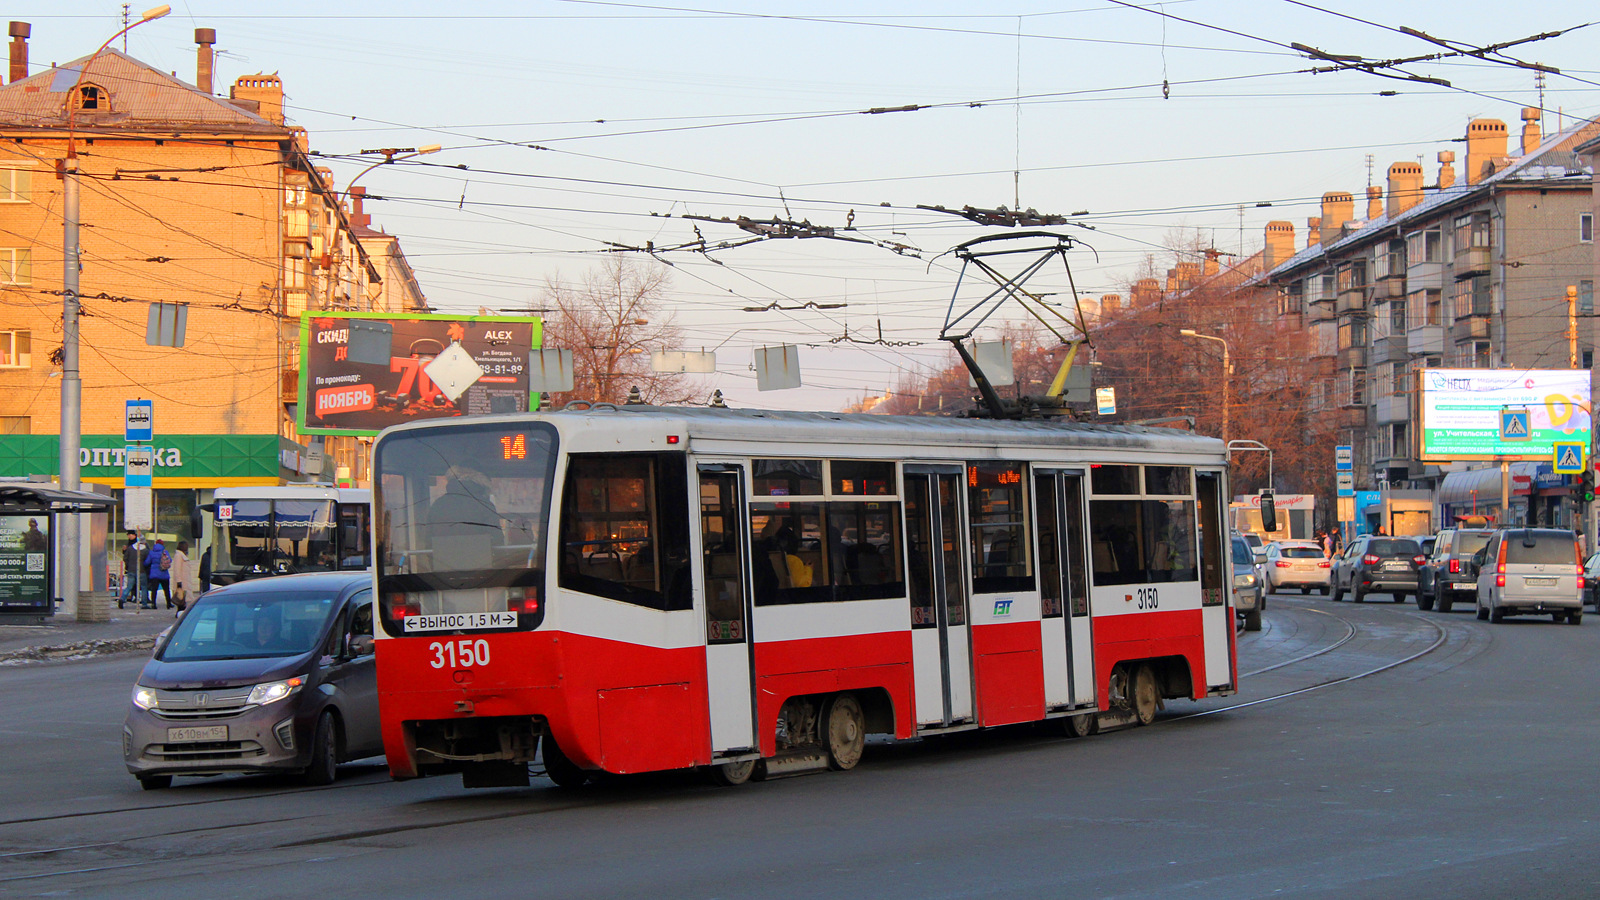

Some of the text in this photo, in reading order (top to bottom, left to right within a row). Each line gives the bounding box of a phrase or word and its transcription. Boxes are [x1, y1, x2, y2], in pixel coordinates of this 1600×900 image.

[484, 330, 513, 340] ALEX
[315, 374, 361, 386] По промокоду:
[1447, 377, 1472, 391] HELIX
[319, 390, 372, 410] НОЯБРЬ
[1433, 430, 1444, 438] ул.
[1446, 430, 1494, 438] Учительская,
[500, 433, 527, 460] 14
[80, 447, 183, 467] оптка
[220, 507, 231, 517] 28
[1137, 587, 1159, 610] 3150
[420, 613, 500, 629] ВЫНОС 1,5 М
[428, 638, 490, 669] 3150
